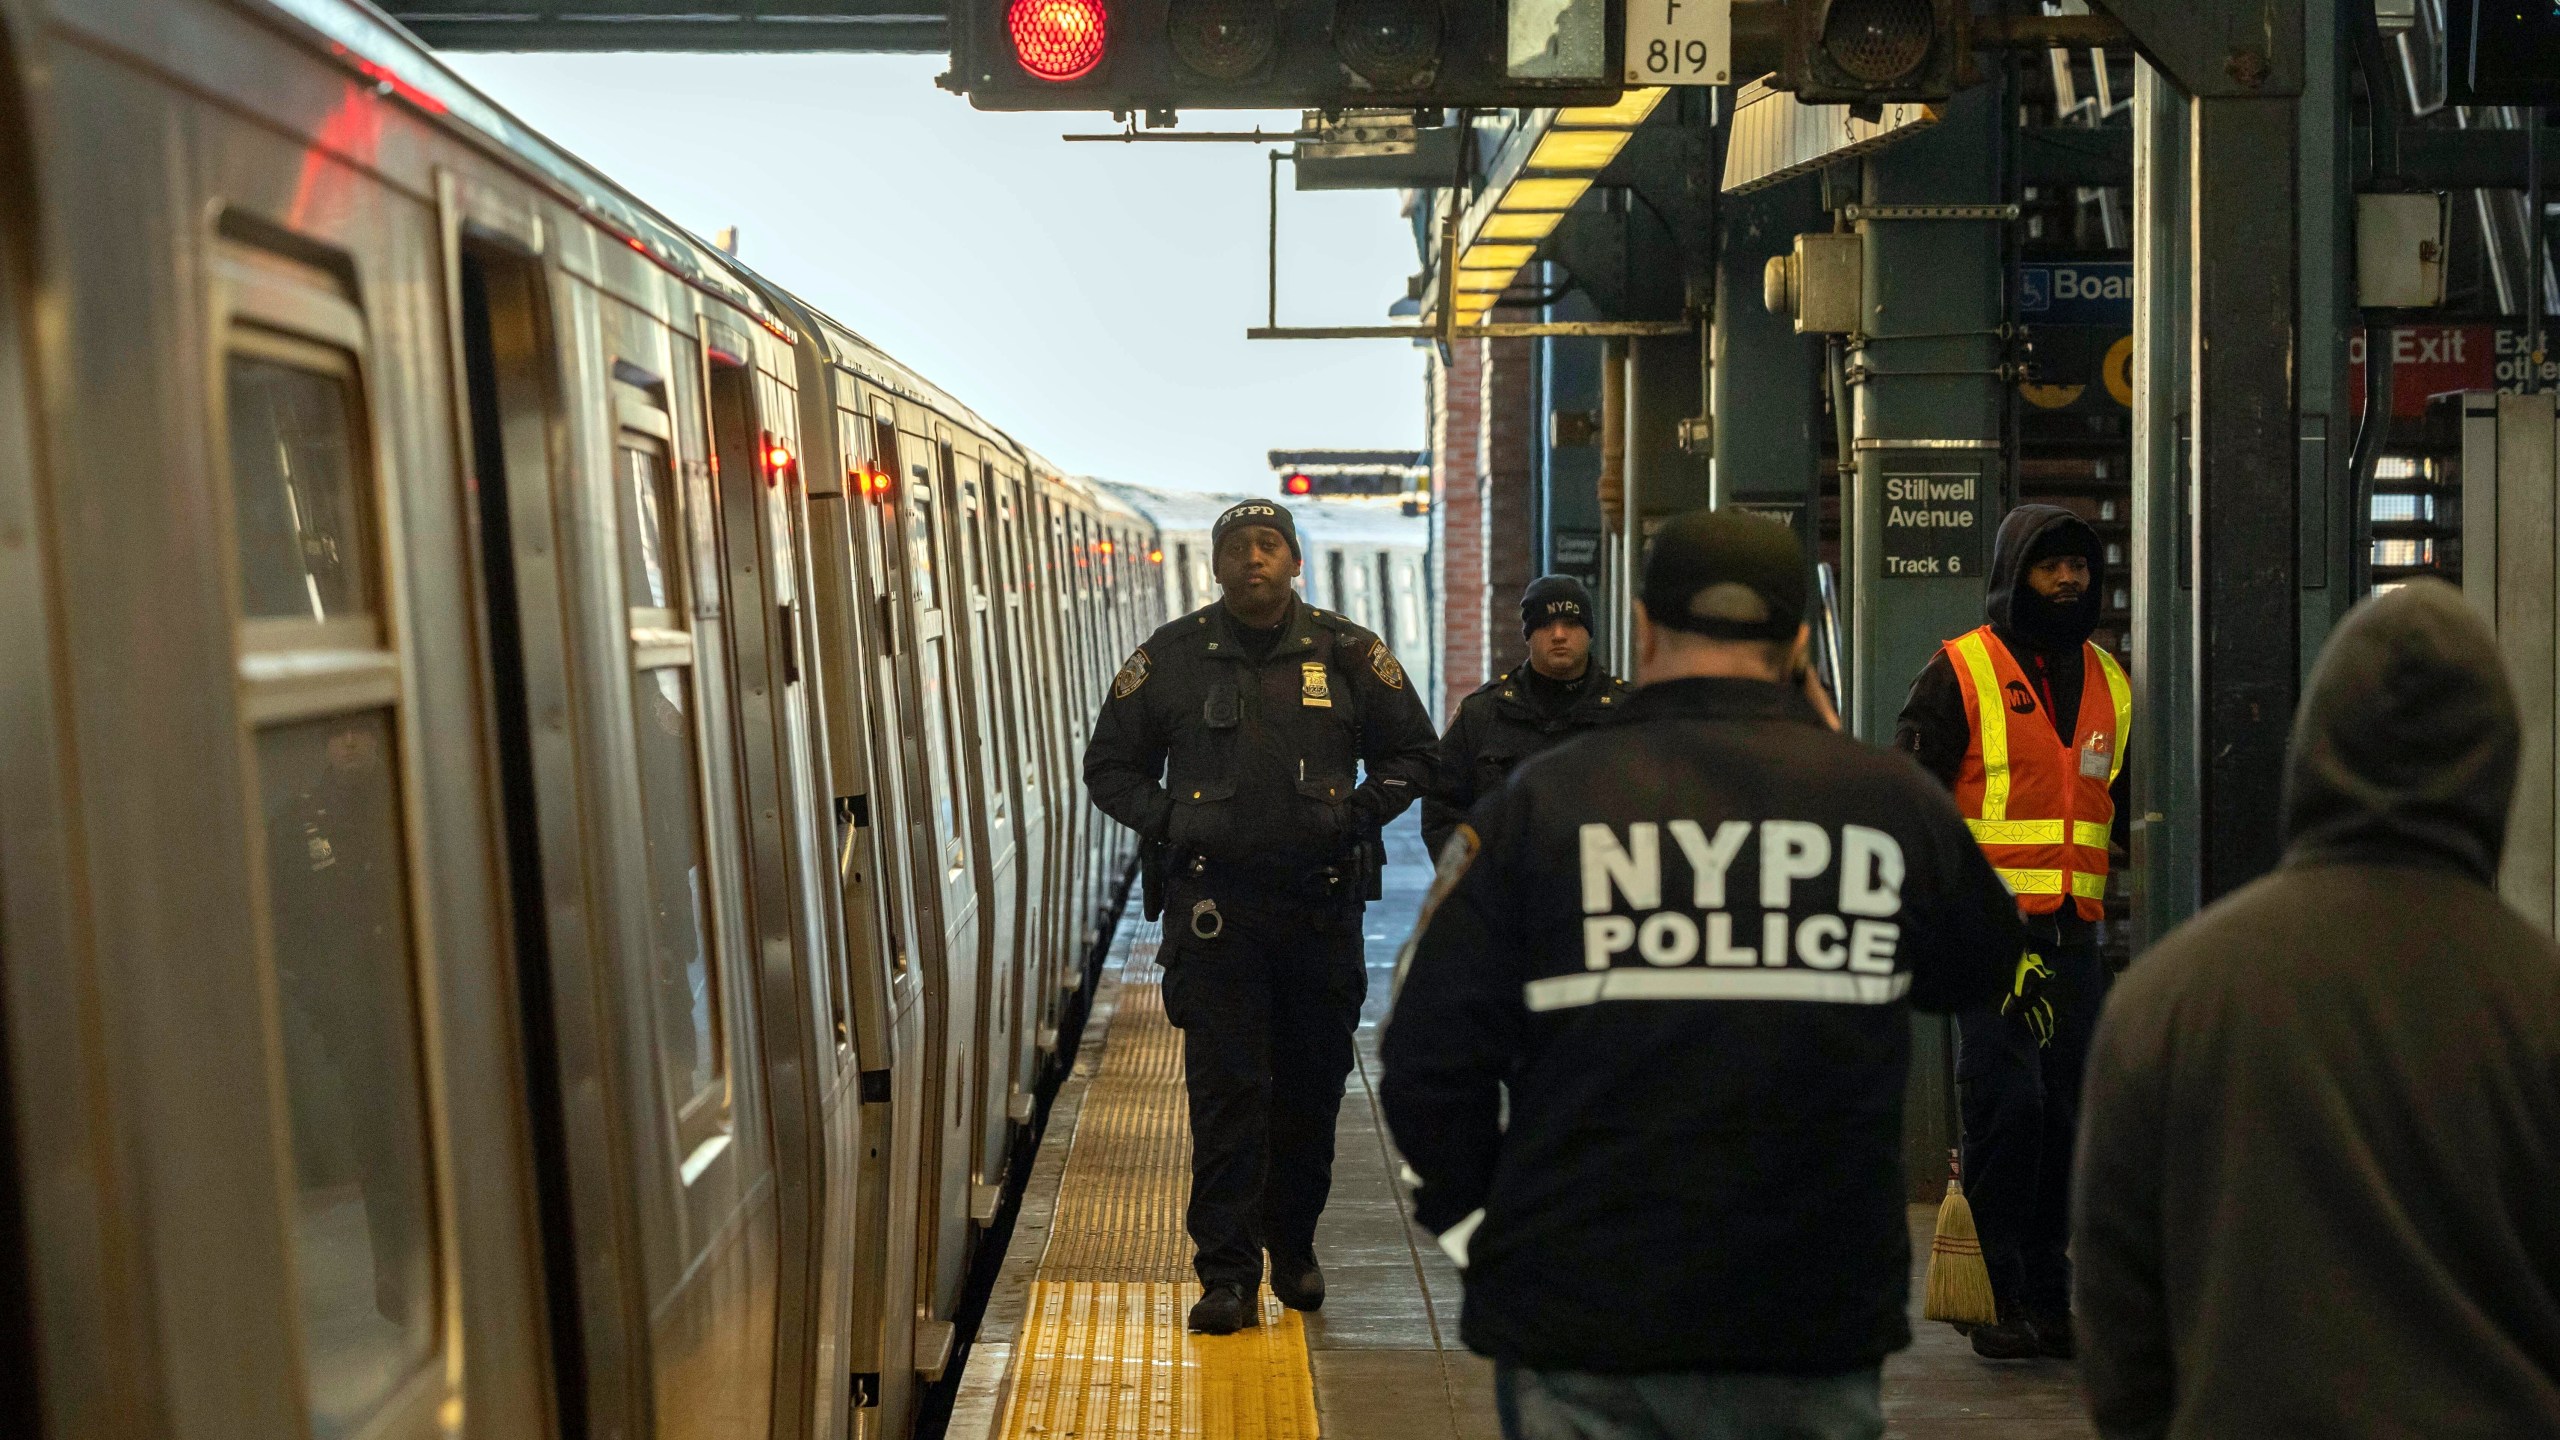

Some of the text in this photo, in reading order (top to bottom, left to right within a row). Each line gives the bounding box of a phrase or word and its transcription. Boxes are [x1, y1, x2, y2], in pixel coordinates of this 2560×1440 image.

[1647, 39, 1707, 74] 819
[2392, 329, 2466, 364] Exit
[2495, 330, 2548, 354] Ext
[1887, 478, 1975, 500] Stillwell
[1220, 506, 1275, 526] NYPD
[1887, 505, 1974, 527] Avenue
[1887, 556, 1961, 573] Track 6
[1546, 600, 1580, 614] NYPD
[1580, 820, 1905, 917] NYPD
[1583, 911, 1900, 974] POLICE
